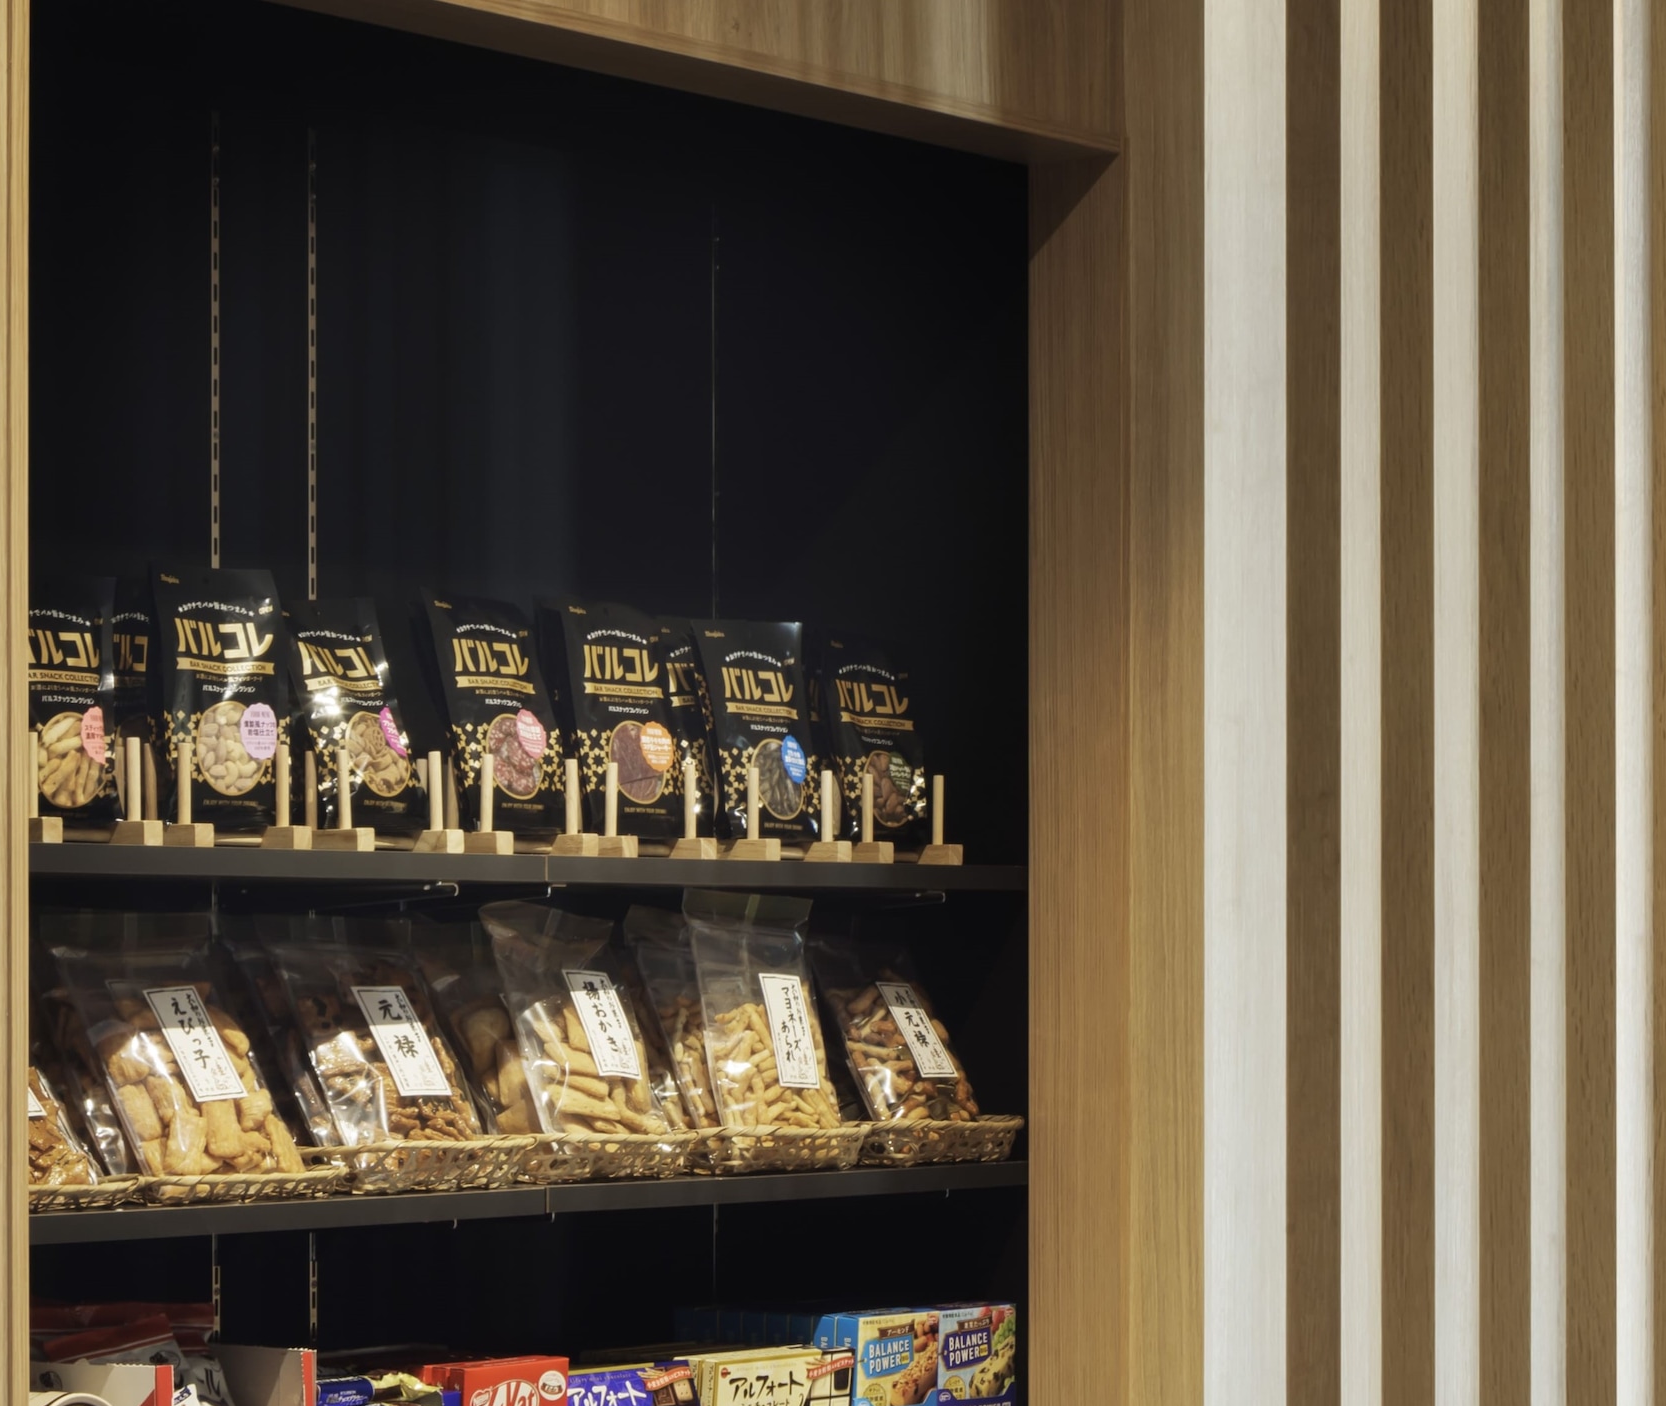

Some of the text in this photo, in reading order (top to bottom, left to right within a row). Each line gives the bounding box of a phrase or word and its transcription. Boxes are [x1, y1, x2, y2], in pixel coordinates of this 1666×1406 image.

[174, 617, 274, 659] バルコレ
[452, 638, 529, 676] バルコレ
[583, 644, 659, 682] バルコレ
[721, 667, 793, 702] バルコレ
[835, 679, 909, 715] バルコレ
[171, 996, 211, 1070] えびっ子
[378, 1000, 419, 1058] 元禄
[781, 986, 802, 1052] マヨネーズ
[781, 1021, 796, 1063] あられ
[869, 1340, 910, 1358] BALANCE
[887, 1326, 910, 1336] アーモンド
[948, 1332, 988, 1351] BALANCE
[869, 1354, 901, 1375] POWER
[949, 1349, 980, 1366] POWER
[729, 1370, 804, 1402] アルフォート
